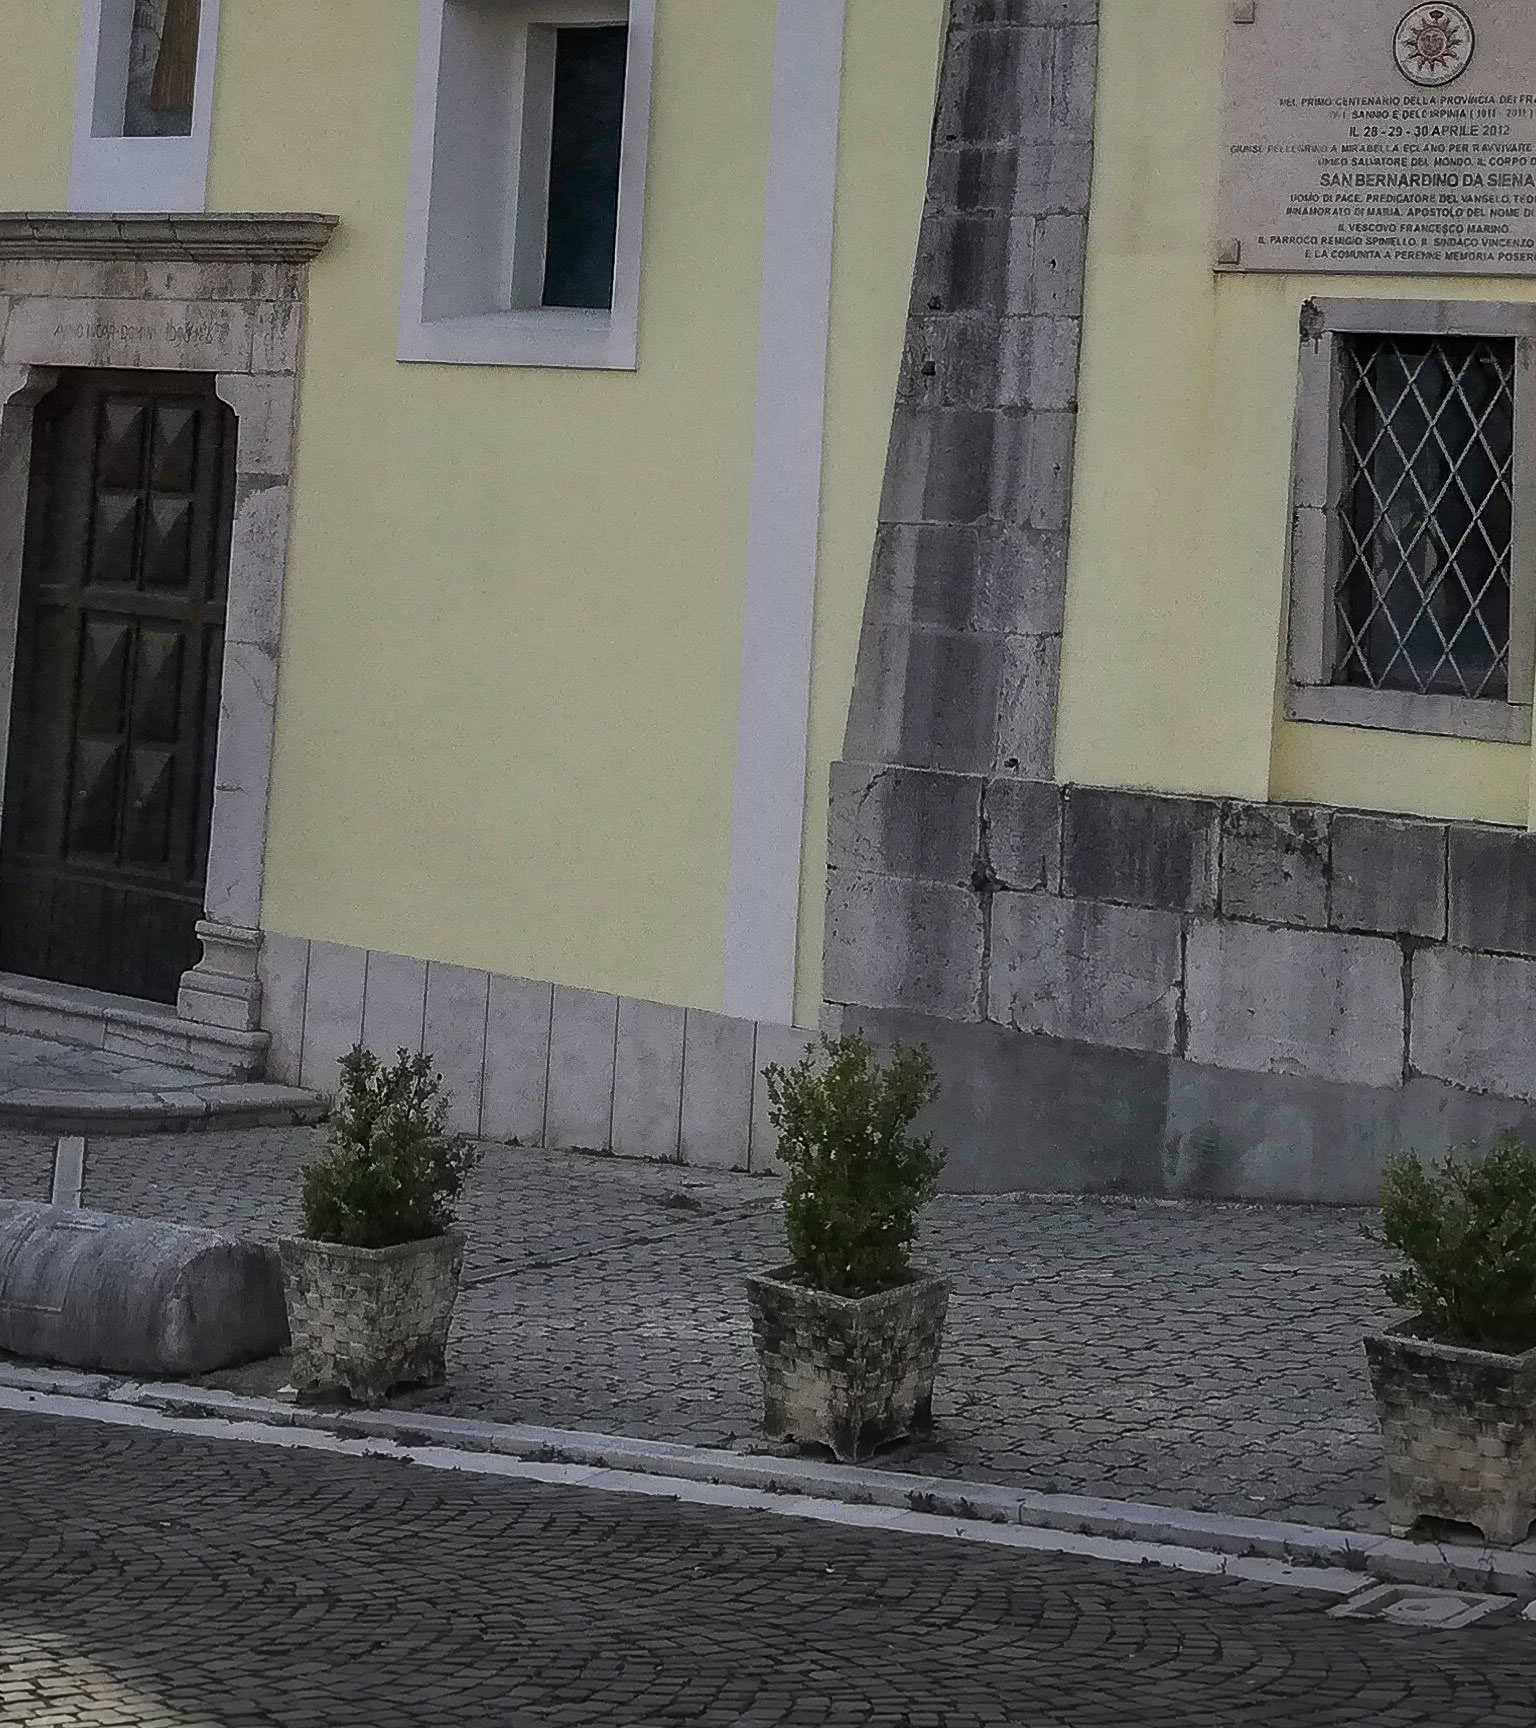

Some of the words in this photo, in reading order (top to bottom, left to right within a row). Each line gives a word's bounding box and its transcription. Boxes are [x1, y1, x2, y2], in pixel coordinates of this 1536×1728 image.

[1301, 98, 1332, 107] PRIMO
[1335, 97, 1400, 106] CENTENARIO
[1404, 96, 1436, 105] DELLA
[1440, 95, 1495, 105] PROVINCIA
[1500, 95, 1516, 104] DEI
[1352, 110, 1389, 119] SANNIO
[1393, 110, 1399, 119] E
[1349, 126, 1359, 138] IL
[1363, 126, 1378, 138] 28
[1388, 126, 1402, 138] 29
[1415, 125, 1428, 137] 30
[1431, 125, 1480, 137] APRILE
[1482, 124, 1510, 136] 2012
[1330, 144, 1337, 153] A
[1341, 144, 1399, 153] MIRABELLA
[1403, 144, 1445, 152] ECLANO
[1449, 144, 1470, 152] PER
[1473, 143, 1532, 152] RAVVIVARE
[1352, 158, 1407, 166] SALVATORE
[1411, 158, 1429, 166] DEL
[1477, 157, 1486, 166] IL
[1488, 157, 1527, 166] CORPO
[1320, 173, 1352, 187] SAN
[1355, 173, 1459, 188] BERNARDINO
[1463, 173, 1484, 187] DA
[1487, 173, 1536, 187] SIENA
[1290, 194, 1320, 202] UOMO
[1322, 194, 1333, 202] DI
[1366, 194, 1436, 203] PREDICATORE
[1439, 194, 1458, 204] DEL
[1286, 207, 1351, 216] INNAMORATO
[1354, 208, 1364, 216] DI
[1407, 208, 1464, 218] APOSTOLO
[1466, 208, 1486, 218] DEL
[1490, 208, 1520, 218] NOME
[1524, 208, 1534, 218] DI
[1338, 223, 1344, 232] IL
[1348, 224, 1396, 232] VESCOVO
[1400, 224, 1464, 234] FRANCESCO
[1270, 236, 1318, 244] PARROCO
[1321, 236, 1362, 246] REMIGIO
[1434, 238, 1478, 247] SINDACO
[1481, 238, 1534, 248] VINCENZO
[1315, 250, 1328, 258] LA
[1384, 250, 1392, 259] A
[1394, 250, 1441, 260] PERENNE
[1445, 251, 1494, 261] MEMORIA
